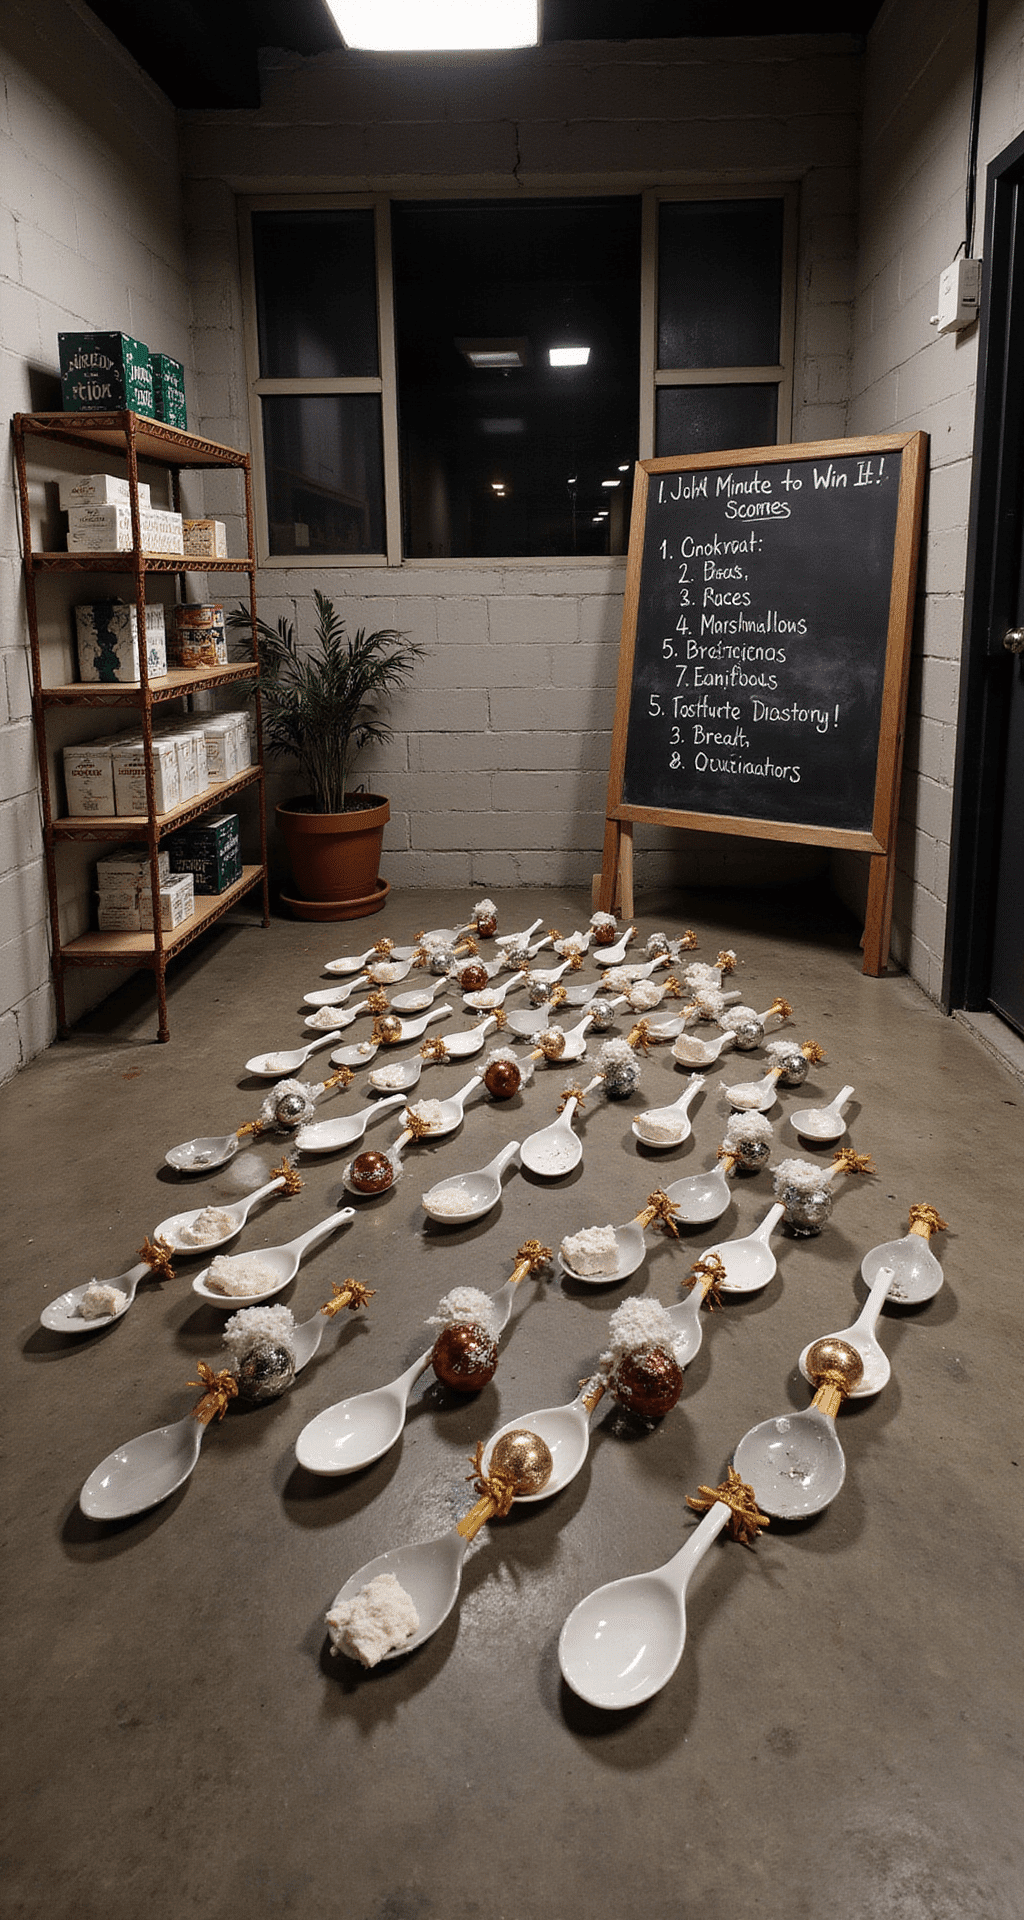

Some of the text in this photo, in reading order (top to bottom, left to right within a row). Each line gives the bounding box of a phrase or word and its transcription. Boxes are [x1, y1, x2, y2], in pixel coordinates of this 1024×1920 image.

[715, 470, 773, 498] Minute
[781, 468, 803, 492] to
[813, 464, 848, 490] Win
[853, 457, 886, 487] It!
[659, 539, 674, 560] 1.
[678, 562, 695, 584] 2.
[679, 588, 696, 607] 3.
[675, 613, 693, 636] 4.
[662, 638, 679, 660] 5.
[675, 664, 690, 688] 7.
[648, 694, 666, 717] 5.
[669, 726, 685, 745] 3.
[668, 751, 686, 770] 8.
